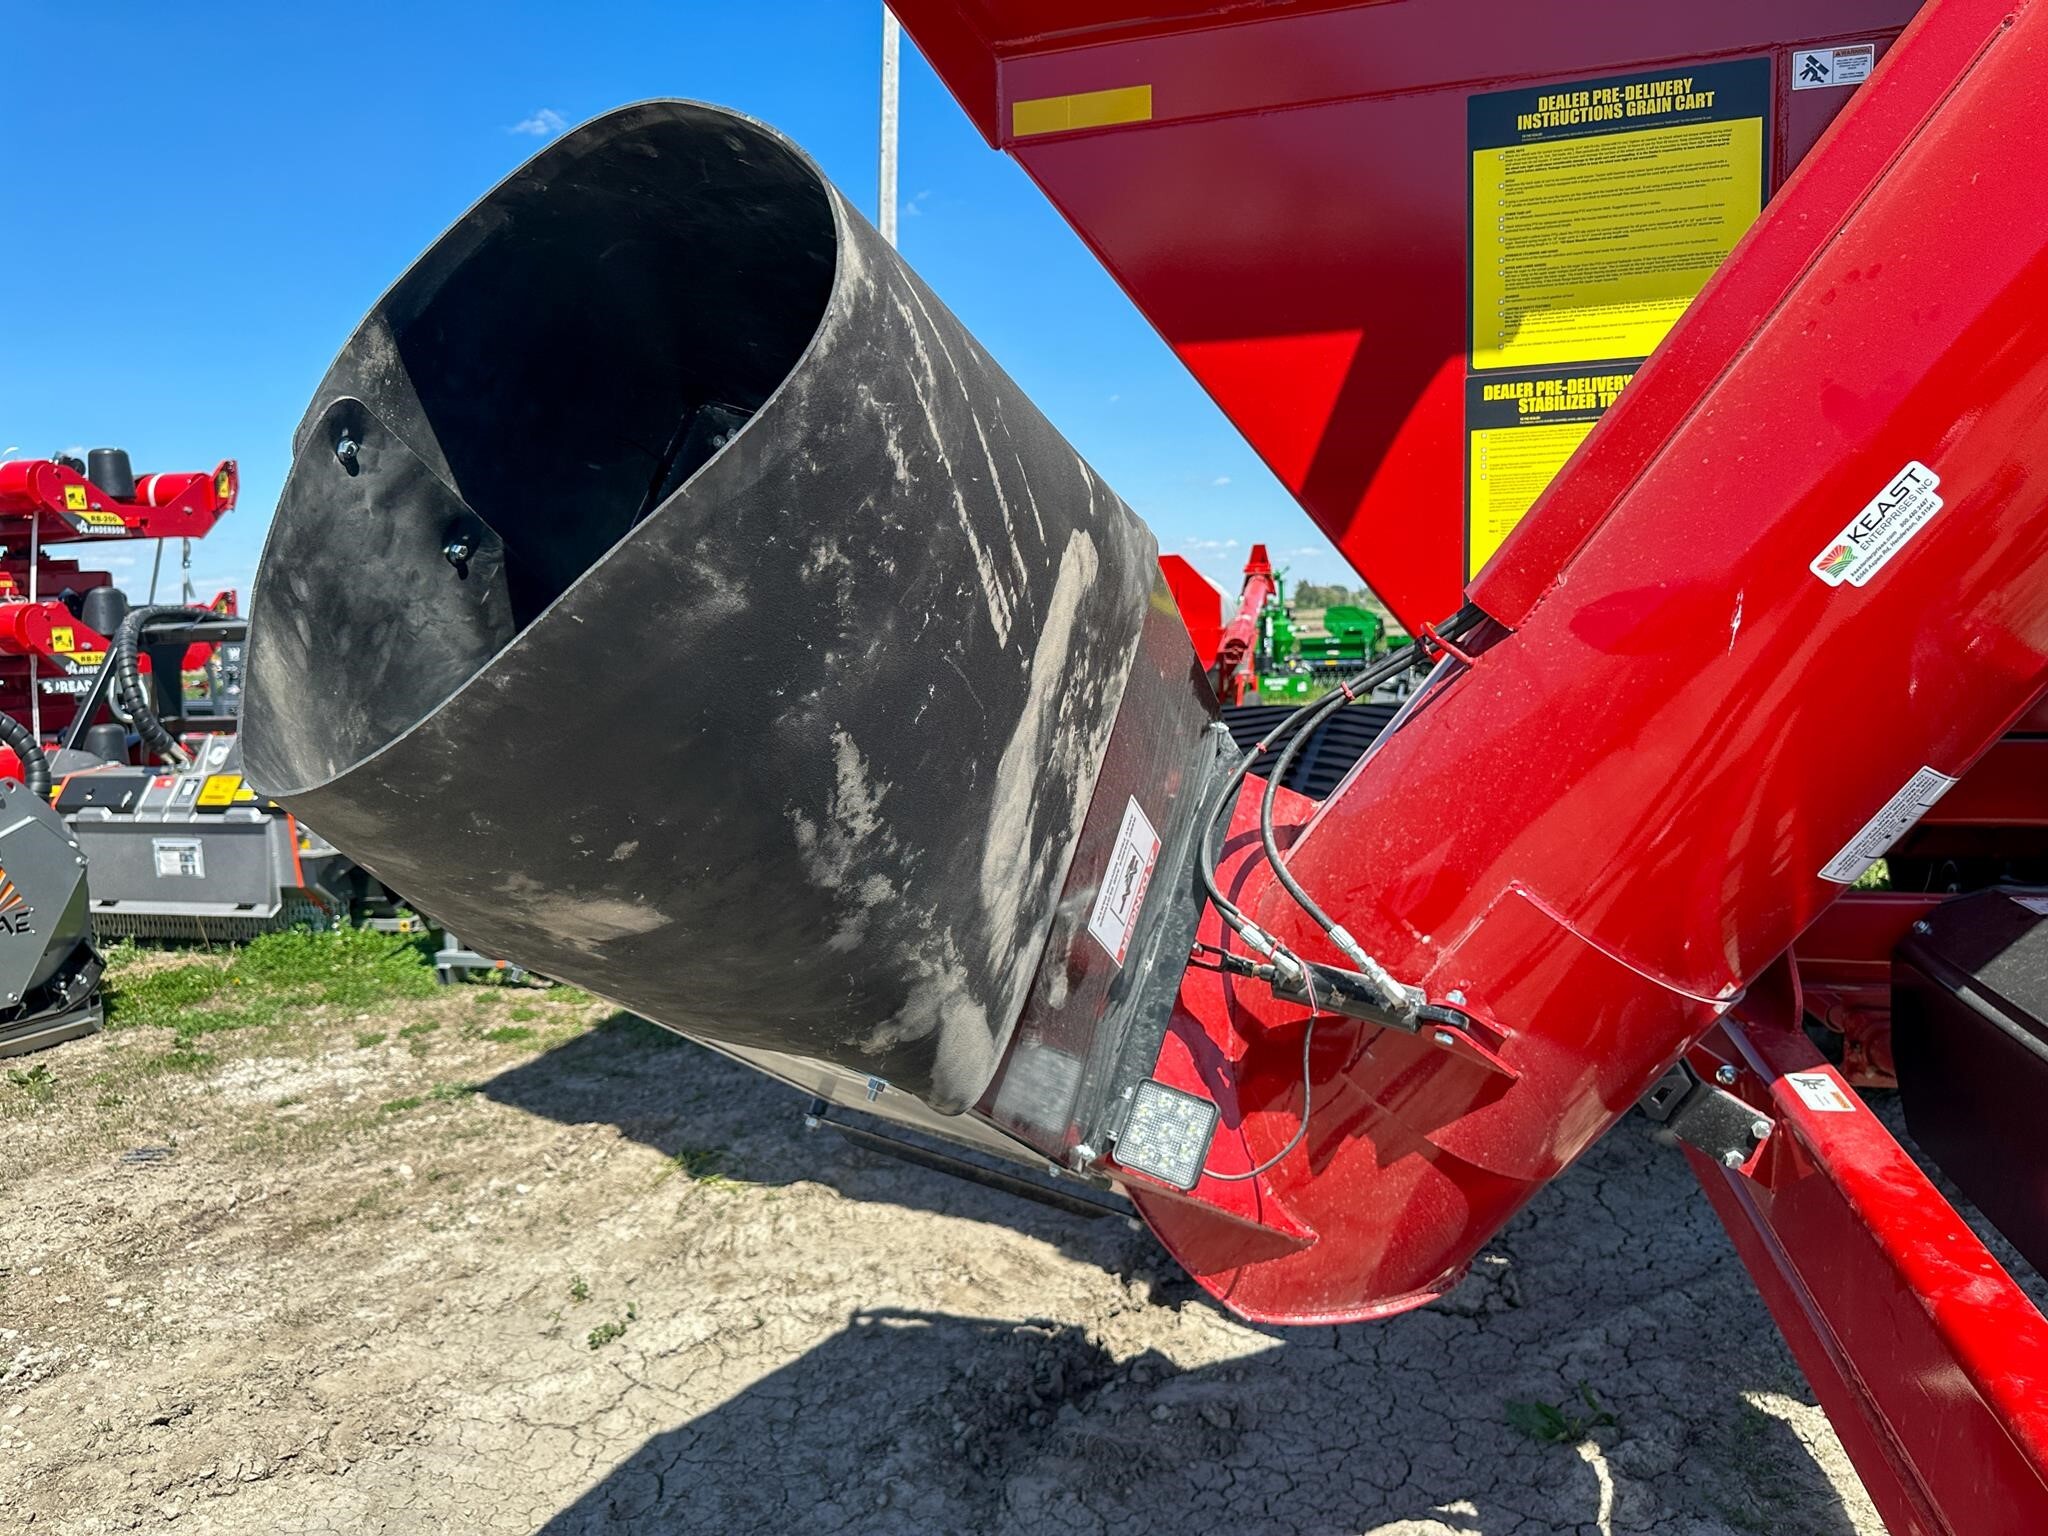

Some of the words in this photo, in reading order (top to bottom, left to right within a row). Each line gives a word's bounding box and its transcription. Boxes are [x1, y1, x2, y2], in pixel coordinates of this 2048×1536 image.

[1517, 103, 1623, 131] INSTRUCTIONS
[1626, 96, 1672, 117] GRAIN
[1675, 91, 1715, 111] CART
[1538, 91, 1589, 113] DEALER
[1593, 77, 1693, 103] PRE-DELIVERY
[1483, 382, 1534, 401] DEALER
[1536, 375, 1633, 397] PRE-DELIVERY
[1518, 393, 1596, 414] STABILIZER
[1847, 467, 1921, 544] KEAST
[1860, 494, 1918, 551] ENTERPRISES
[1915, 478, 1933, 495] INC
